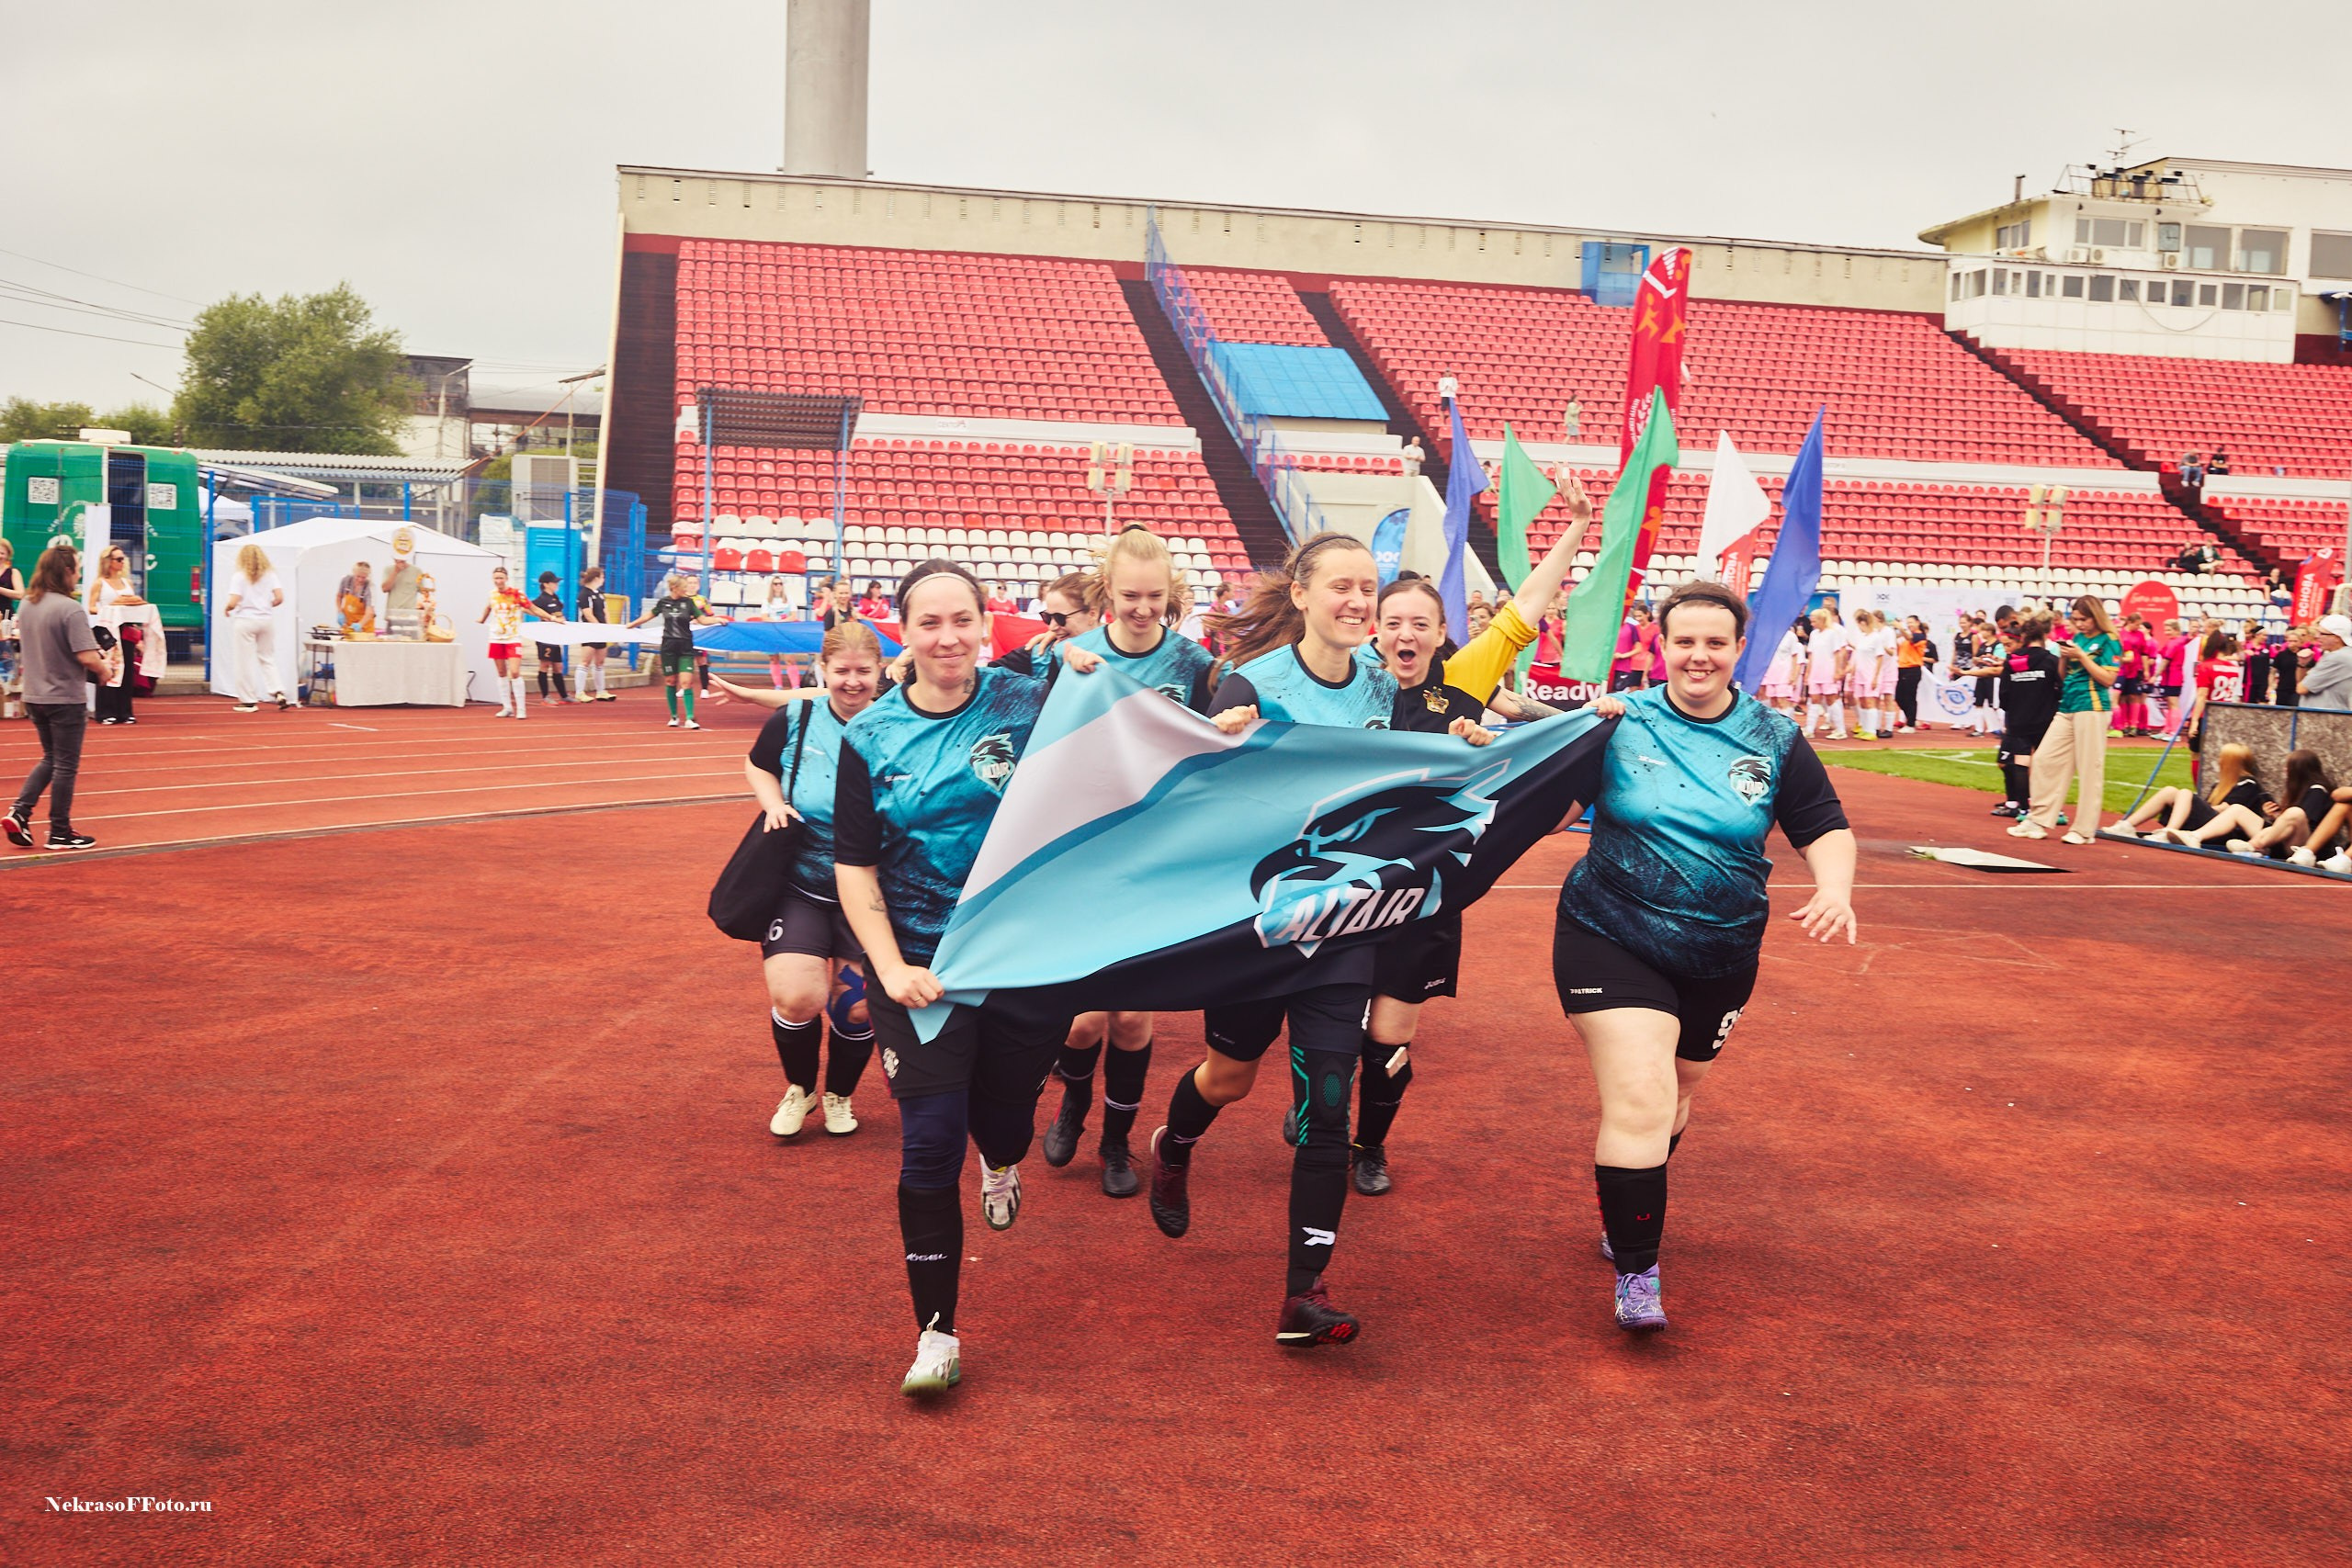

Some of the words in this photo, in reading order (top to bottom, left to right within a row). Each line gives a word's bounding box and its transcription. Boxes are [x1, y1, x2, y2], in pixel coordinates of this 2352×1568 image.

[2297, 572, 2315, 618] ОСНОВА
[1524, 679, 1602, 702] Ready
[1273, 886, 1426, 942] ALTAIR
